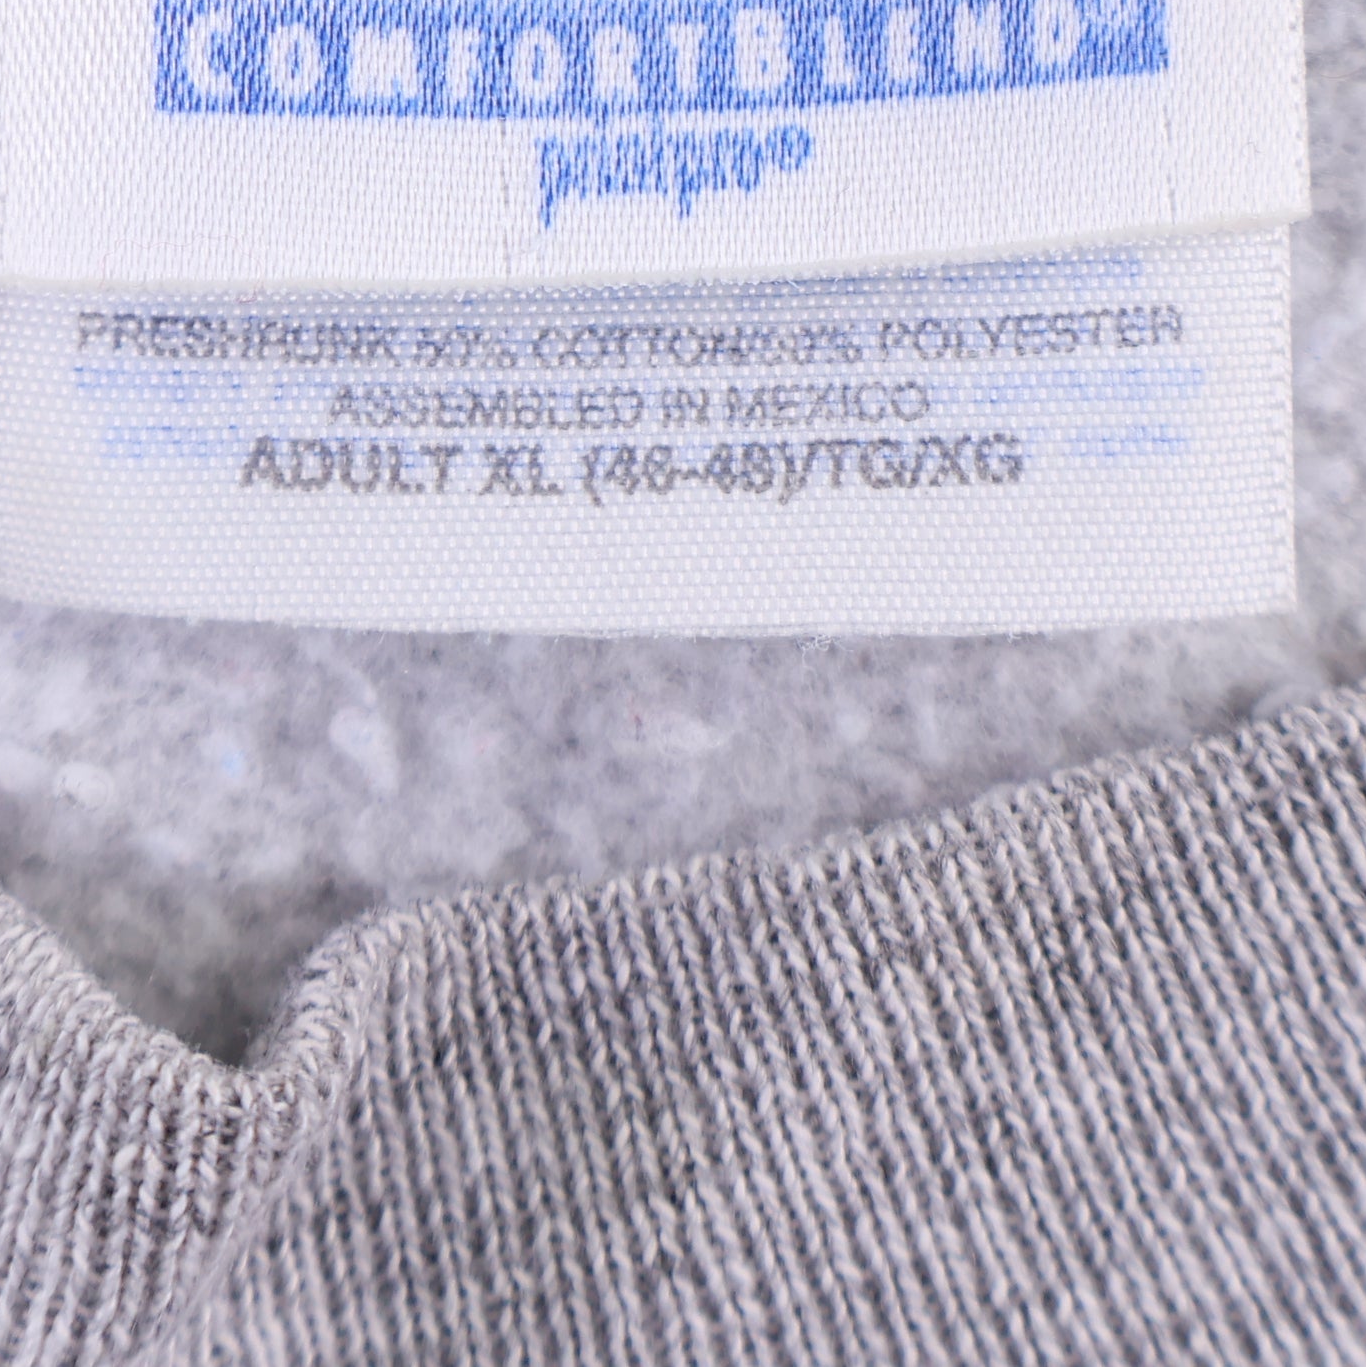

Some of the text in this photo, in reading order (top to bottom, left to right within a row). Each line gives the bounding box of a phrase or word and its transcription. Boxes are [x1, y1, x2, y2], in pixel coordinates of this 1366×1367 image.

[77, 310, 401, 366] PRESHRUNK
[878, 303, 1184, 362] POLYESTER
[328, 380, 644, 429] ASSEMBLED
[663, 386, 709, 427] IN
[726, 380, 931, 427] MEXICO
[239, 433, 464, 493] ADULT
[479, 442, 565, 496] XL
